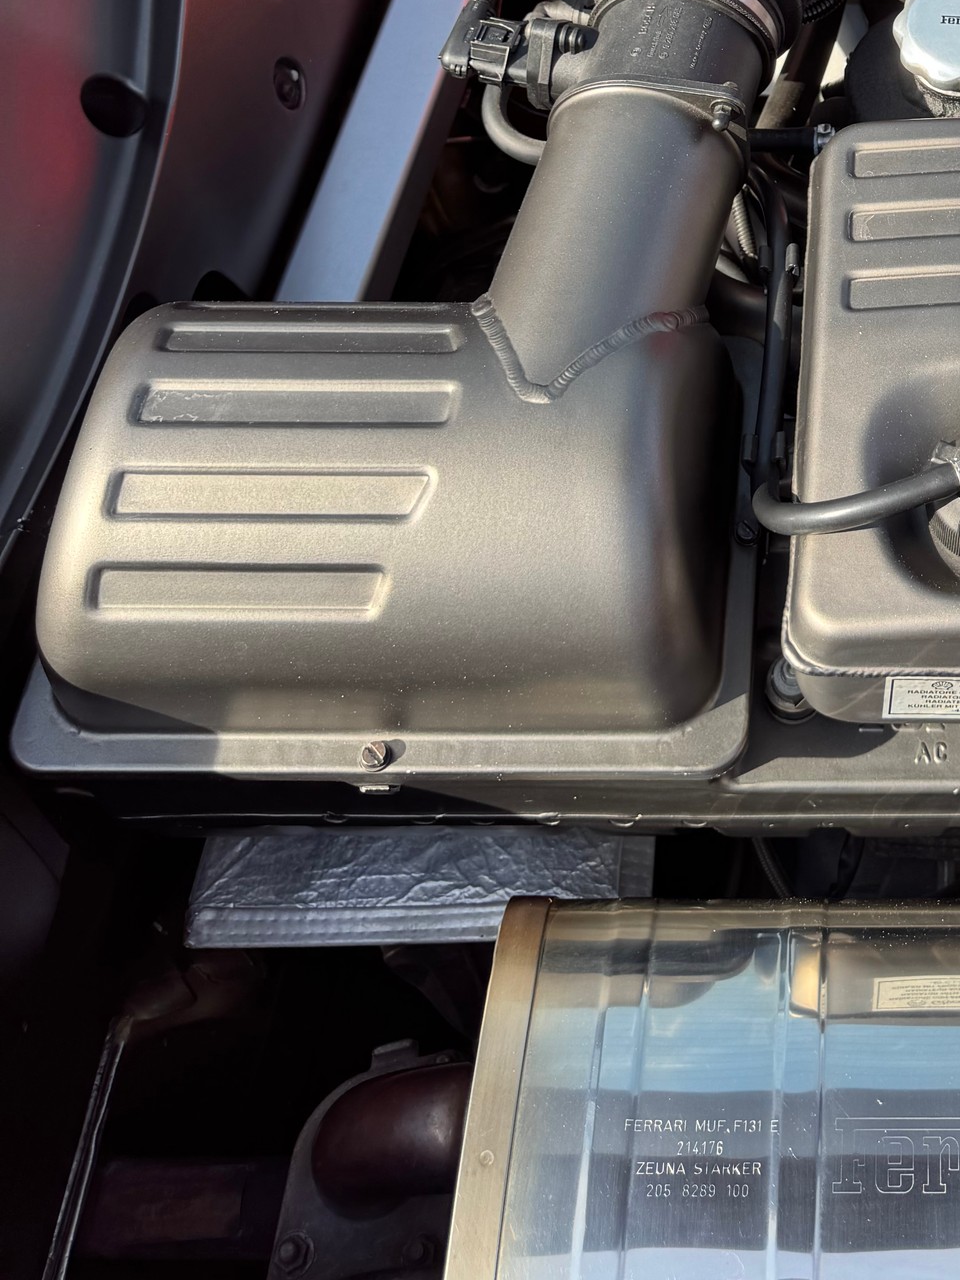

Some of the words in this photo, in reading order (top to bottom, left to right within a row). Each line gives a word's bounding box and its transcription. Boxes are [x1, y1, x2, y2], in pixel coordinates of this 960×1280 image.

[914, 740, 948, 765] AC
[624, 1118, 687, 1132] FERRARI
[770, 1119, 779, 1133] E
[635, 1161, 686, 1175] ZEUNA
[646, 1183, 672, 1198] 205
[682, 1183, 717, 1198] 8289
[727, 1183, 750, 1198] 100
